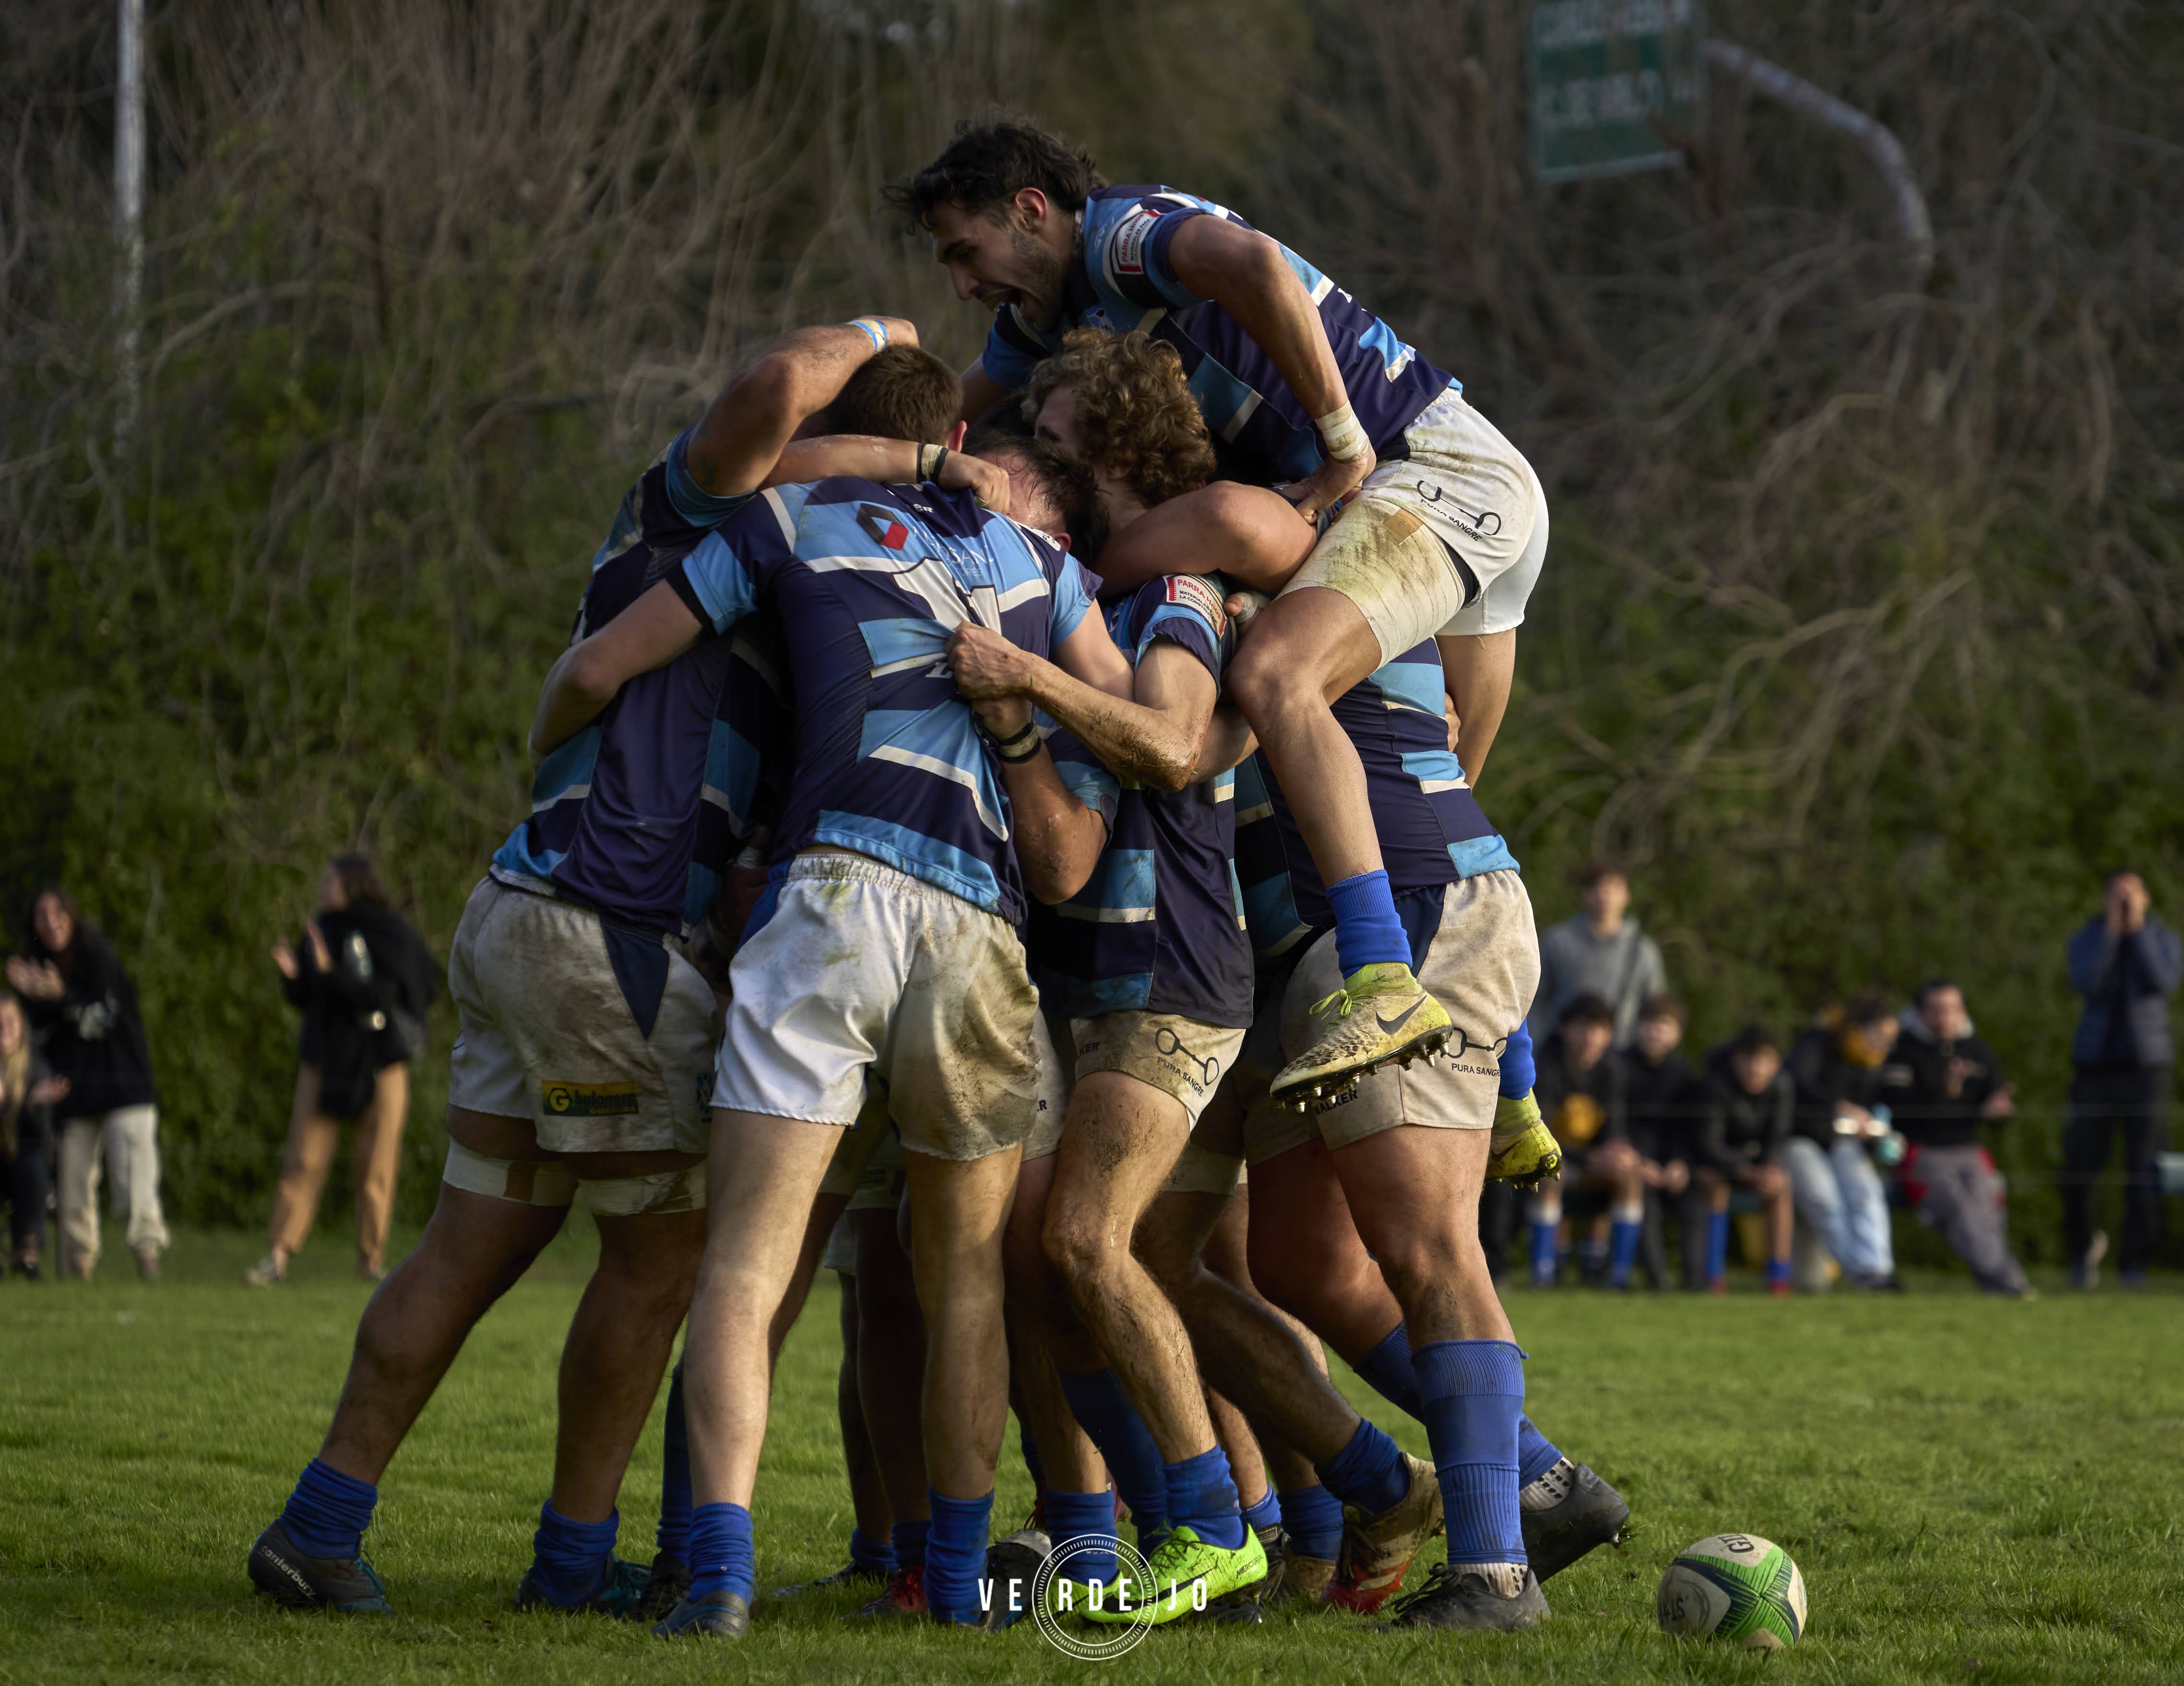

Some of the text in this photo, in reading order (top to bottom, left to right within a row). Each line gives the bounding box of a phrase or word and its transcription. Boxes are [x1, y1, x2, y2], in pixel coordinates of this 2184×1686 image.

[1122, 233, 1131, 261] PARRA
[1448, 515, 1482, 542] SANGRE
[1177, 579, 1205, 599] PARRA
[1179, 590, 1210, 610] MATERIALES
[1156, 1056, 1204, 1097] PURA SANGRE
[1451, 1063, 1501, 1077] PURA SANGR
[261, 1545, 318, 1597] canterbury
[1235, 1555, 1264, 1579] MERCURIAL
